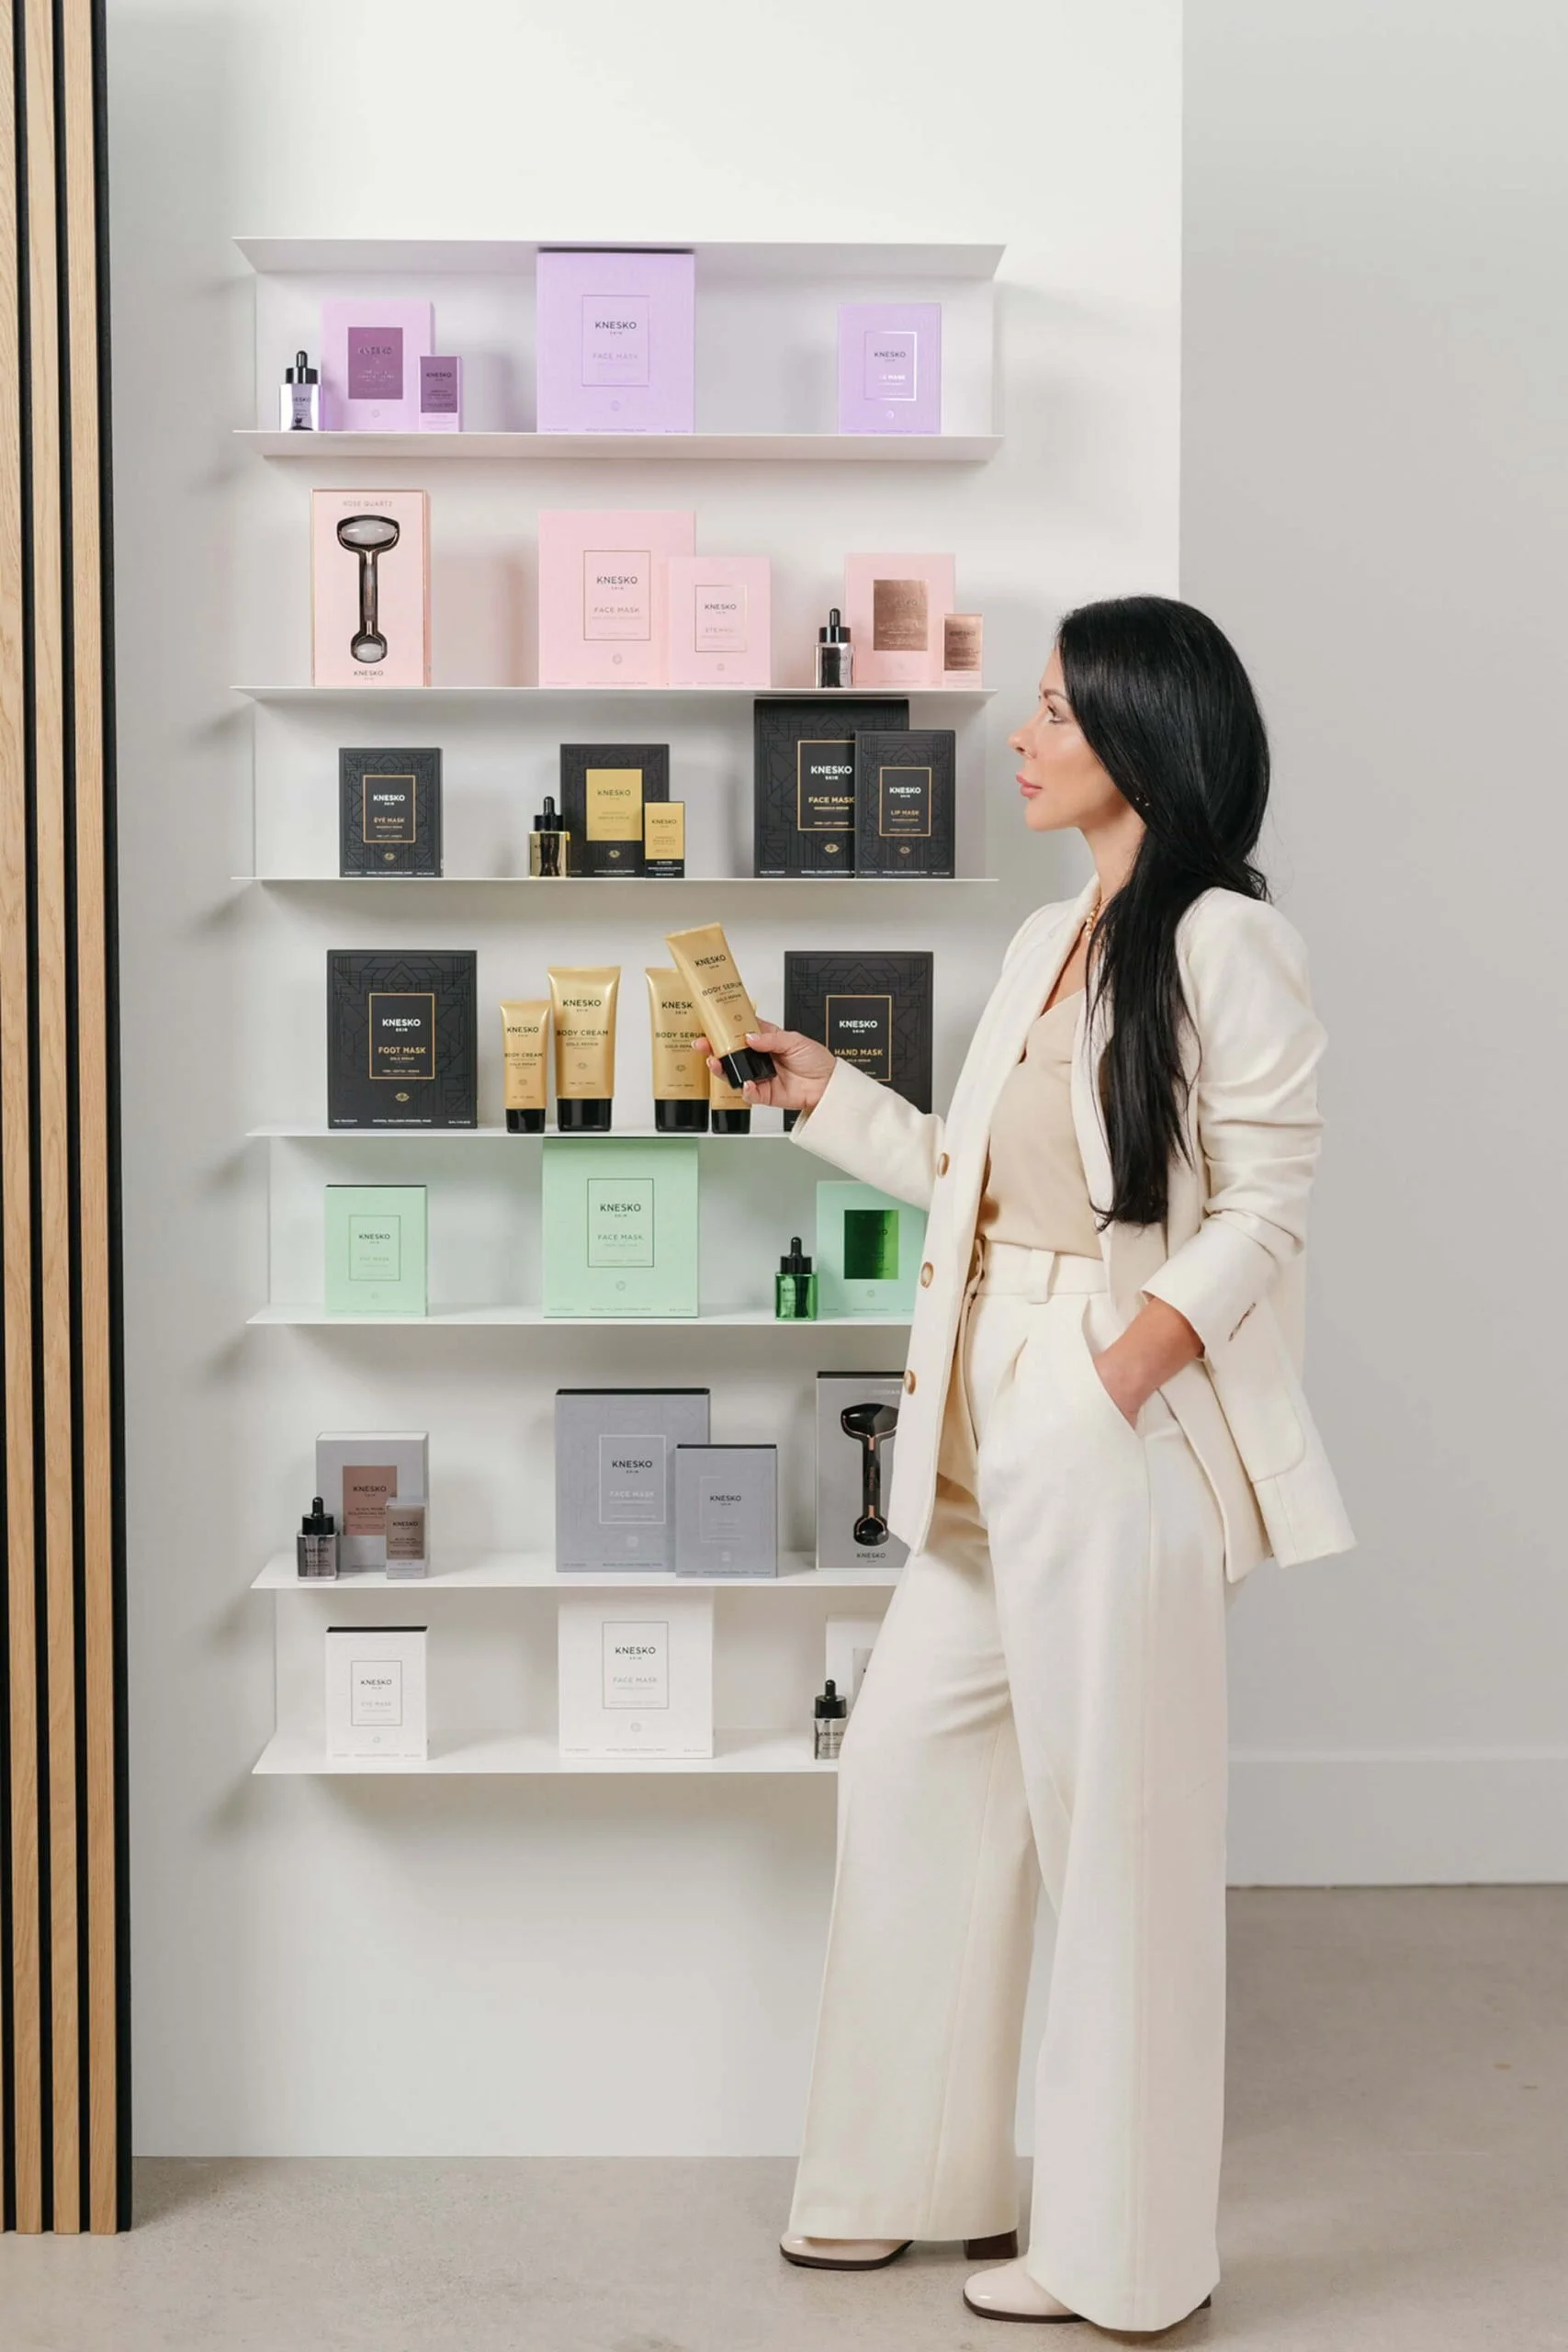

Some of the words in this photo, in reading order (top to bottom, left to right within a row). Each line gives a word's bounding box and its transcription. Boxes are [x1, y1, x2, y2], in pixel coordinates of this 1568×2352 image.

[595, 322, 637, 330] KNESKO
[596, 576, 637, 584] KNESKO
[810, 765, 852, 774] KNESKO
[694, 954, 726, 967] KNESKO
[702, 985, 722, 996] BODY
[382, 1019, 421, 1027] KNESKO
[840, 1020, 878, 1028] KNESKO
[600, 1204, 641, 1212] KNESKO
[615, 1646, 656, 1655] KNESKO
